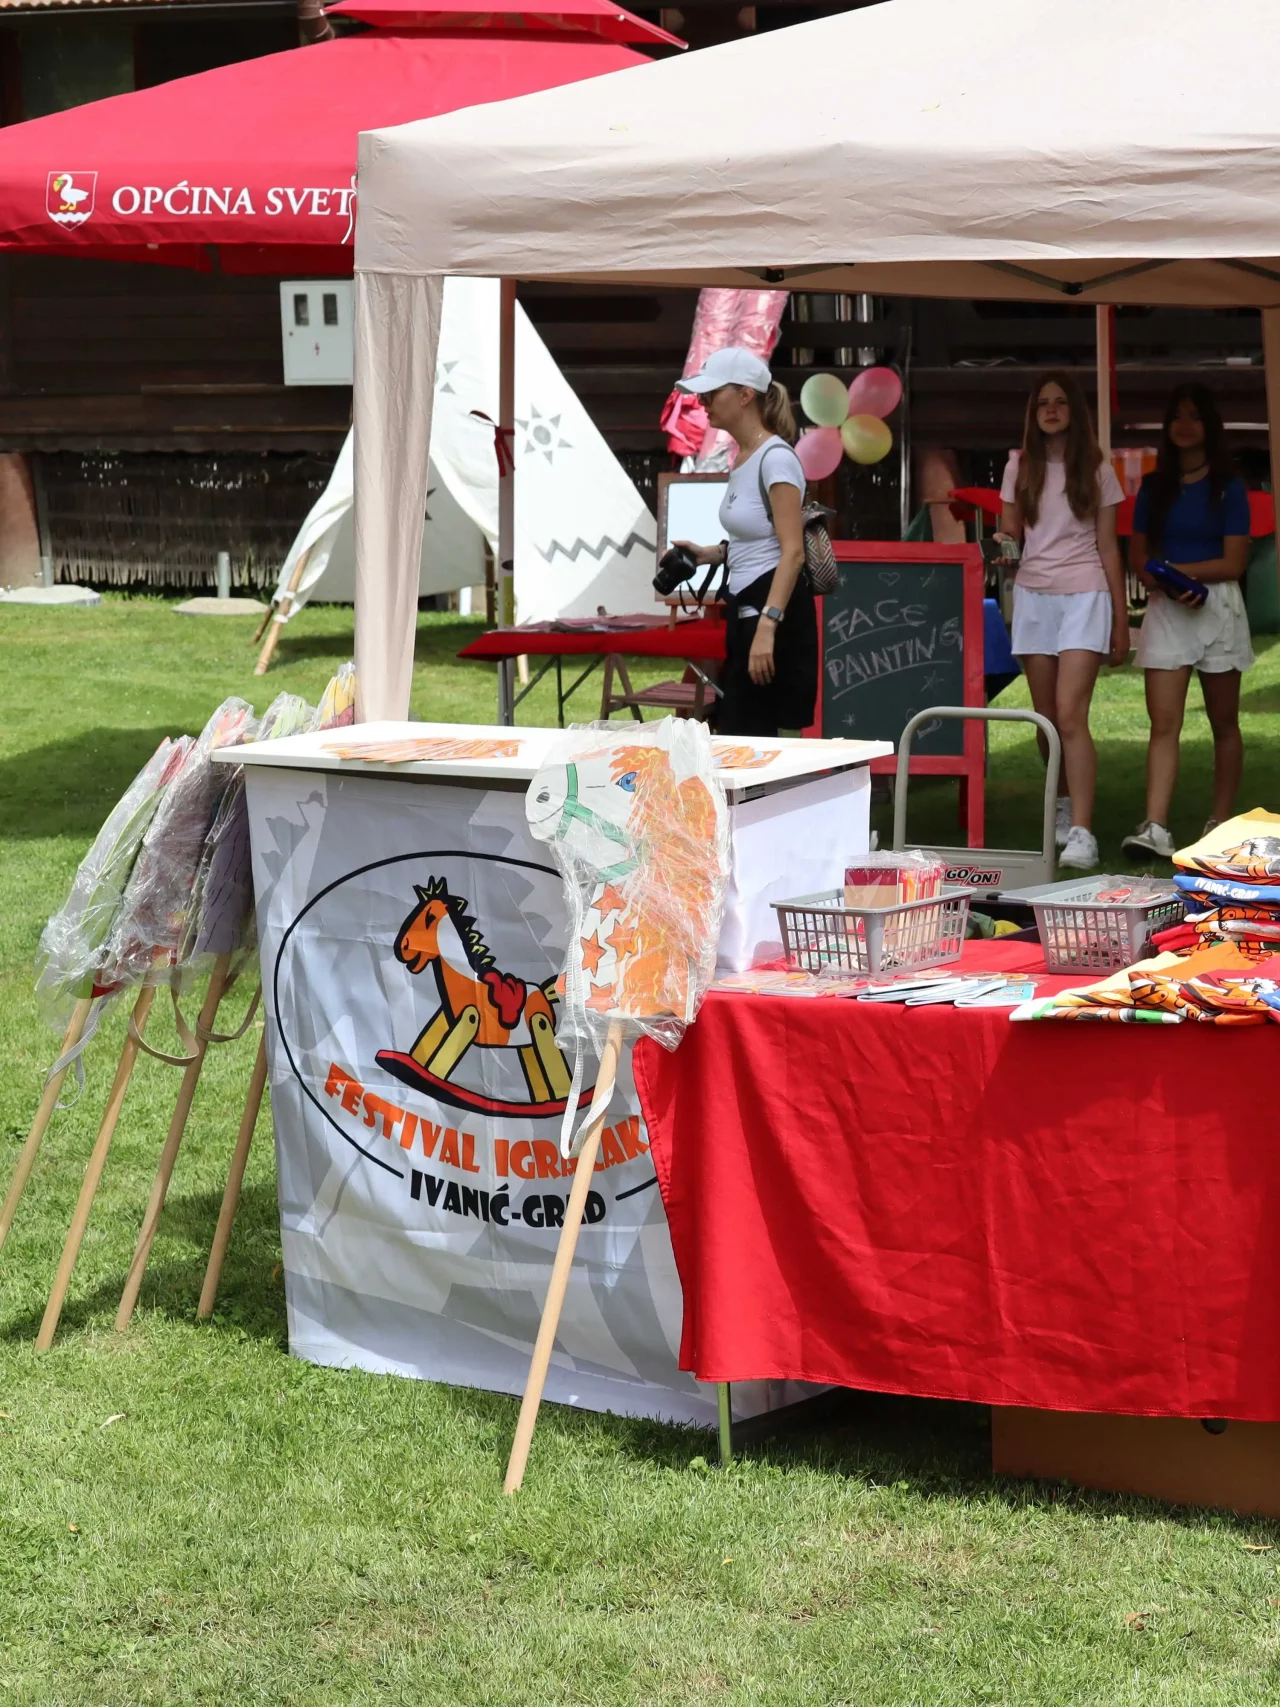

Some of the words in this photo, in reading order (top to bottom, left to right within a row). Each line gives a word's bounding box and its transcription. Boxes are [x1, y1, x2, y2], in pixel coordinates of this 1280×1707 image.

[112, 180, 256, 215] OPĆINA
[827, 599, 928, 642] FACE
[825, 616, 964, 688] PAINTING
[324, 1062, 480, 1174] FESTIVAL
[410, 1169, 607, 1228] IVANIĆ-GRD
